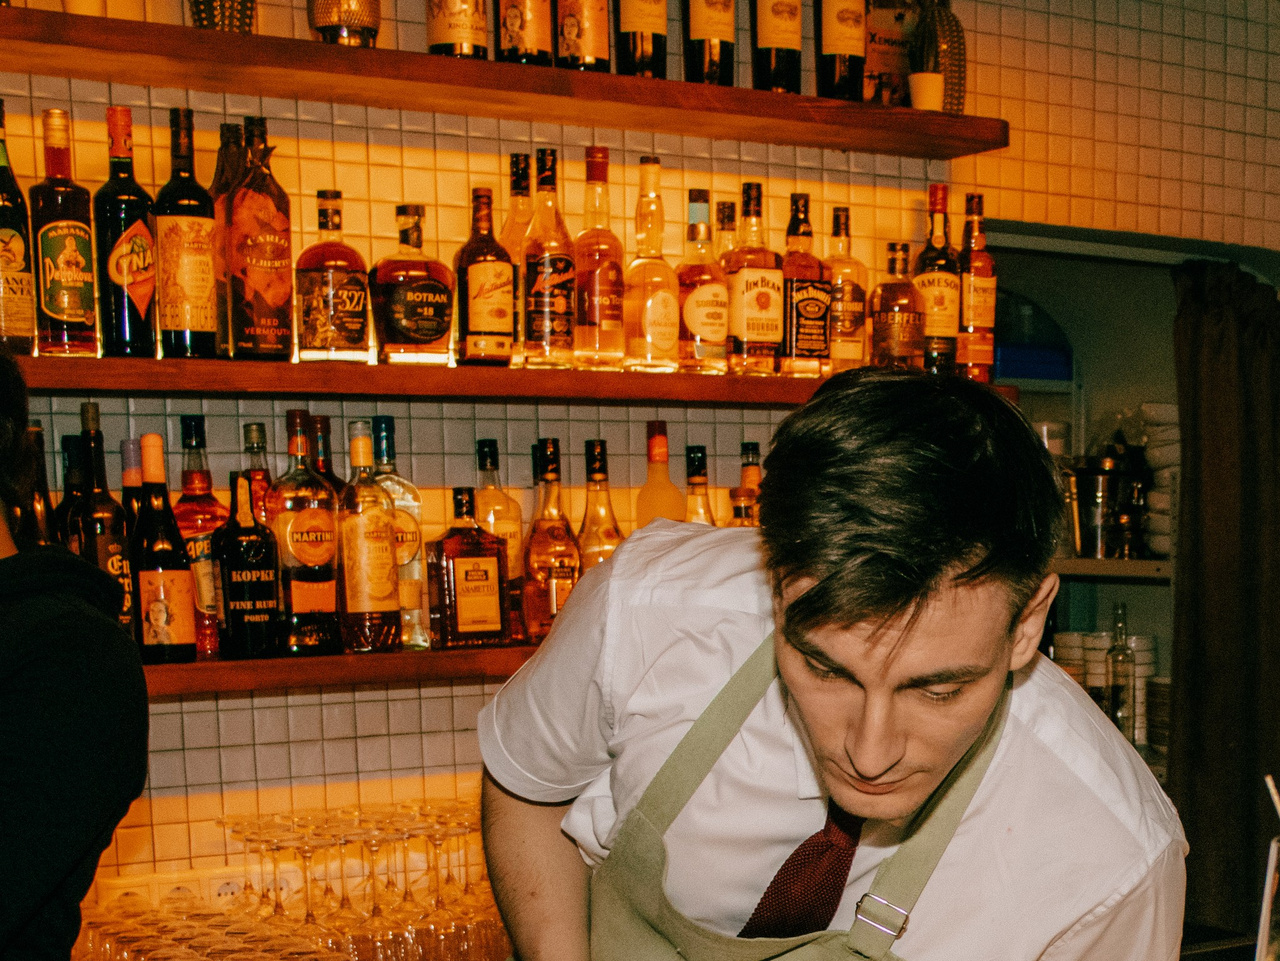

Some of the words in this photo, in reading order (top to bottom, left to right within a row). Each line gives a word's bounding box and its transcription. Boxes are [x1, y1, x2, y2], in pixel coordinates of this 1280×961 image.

[108, 241, 155, 287] CYNA
[338, 290, 366, 311] 327
[406, 291, 447, 303] BOTRAN
[261, 317, 279, 326] RED
[292, 531, 333, 542] MARTINI
[186, 540, 212, 559] APE
[231, 569, 276, 583] KOPKE
[229, 600, 255, 611] FINE
[243, 613, 271, 623] PORTO
